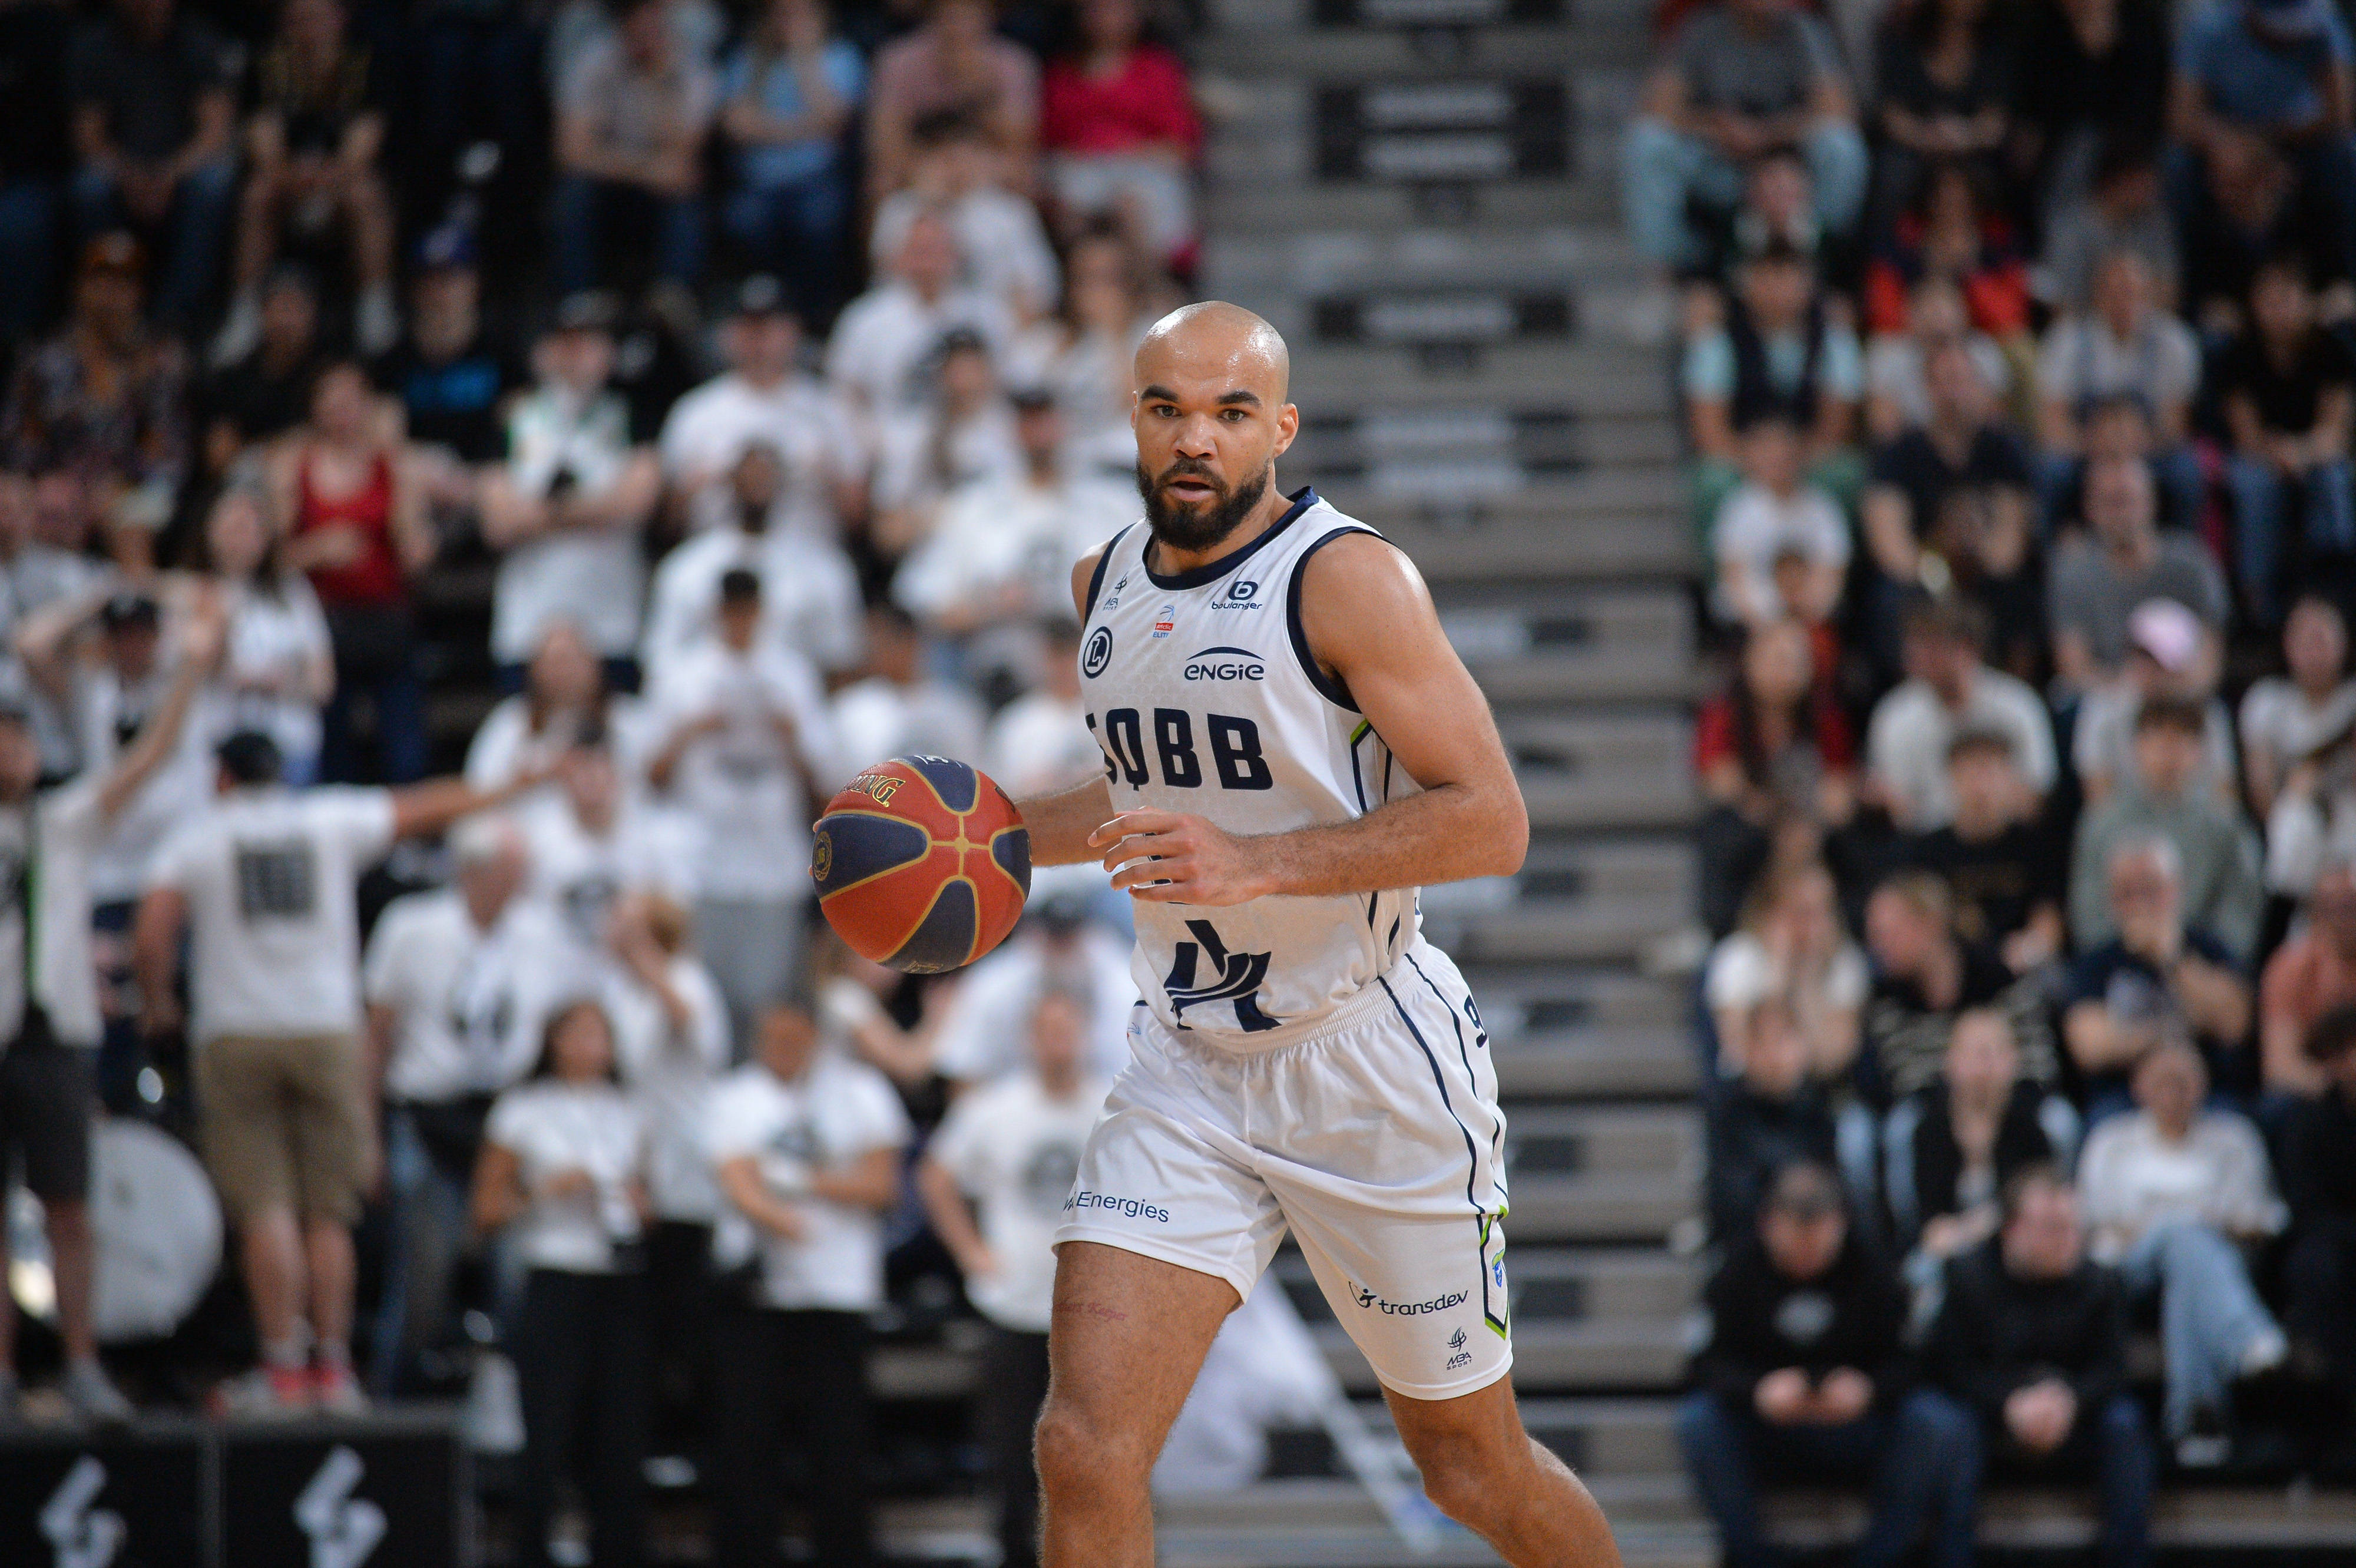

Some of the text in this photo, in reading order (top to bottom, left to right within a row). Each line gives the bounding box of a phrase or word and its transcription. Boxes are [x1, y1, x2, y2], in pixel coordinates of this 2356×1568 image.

[1212, 601, 1262, 610] boulanger
[1064, 1191, 1169, 1223] Energies
[1378, 1290, 1469, 1315] transdev
[1447, 1351, 1472, 1366] MBA
[1447, 1359, 1472, 1370] SPORT
